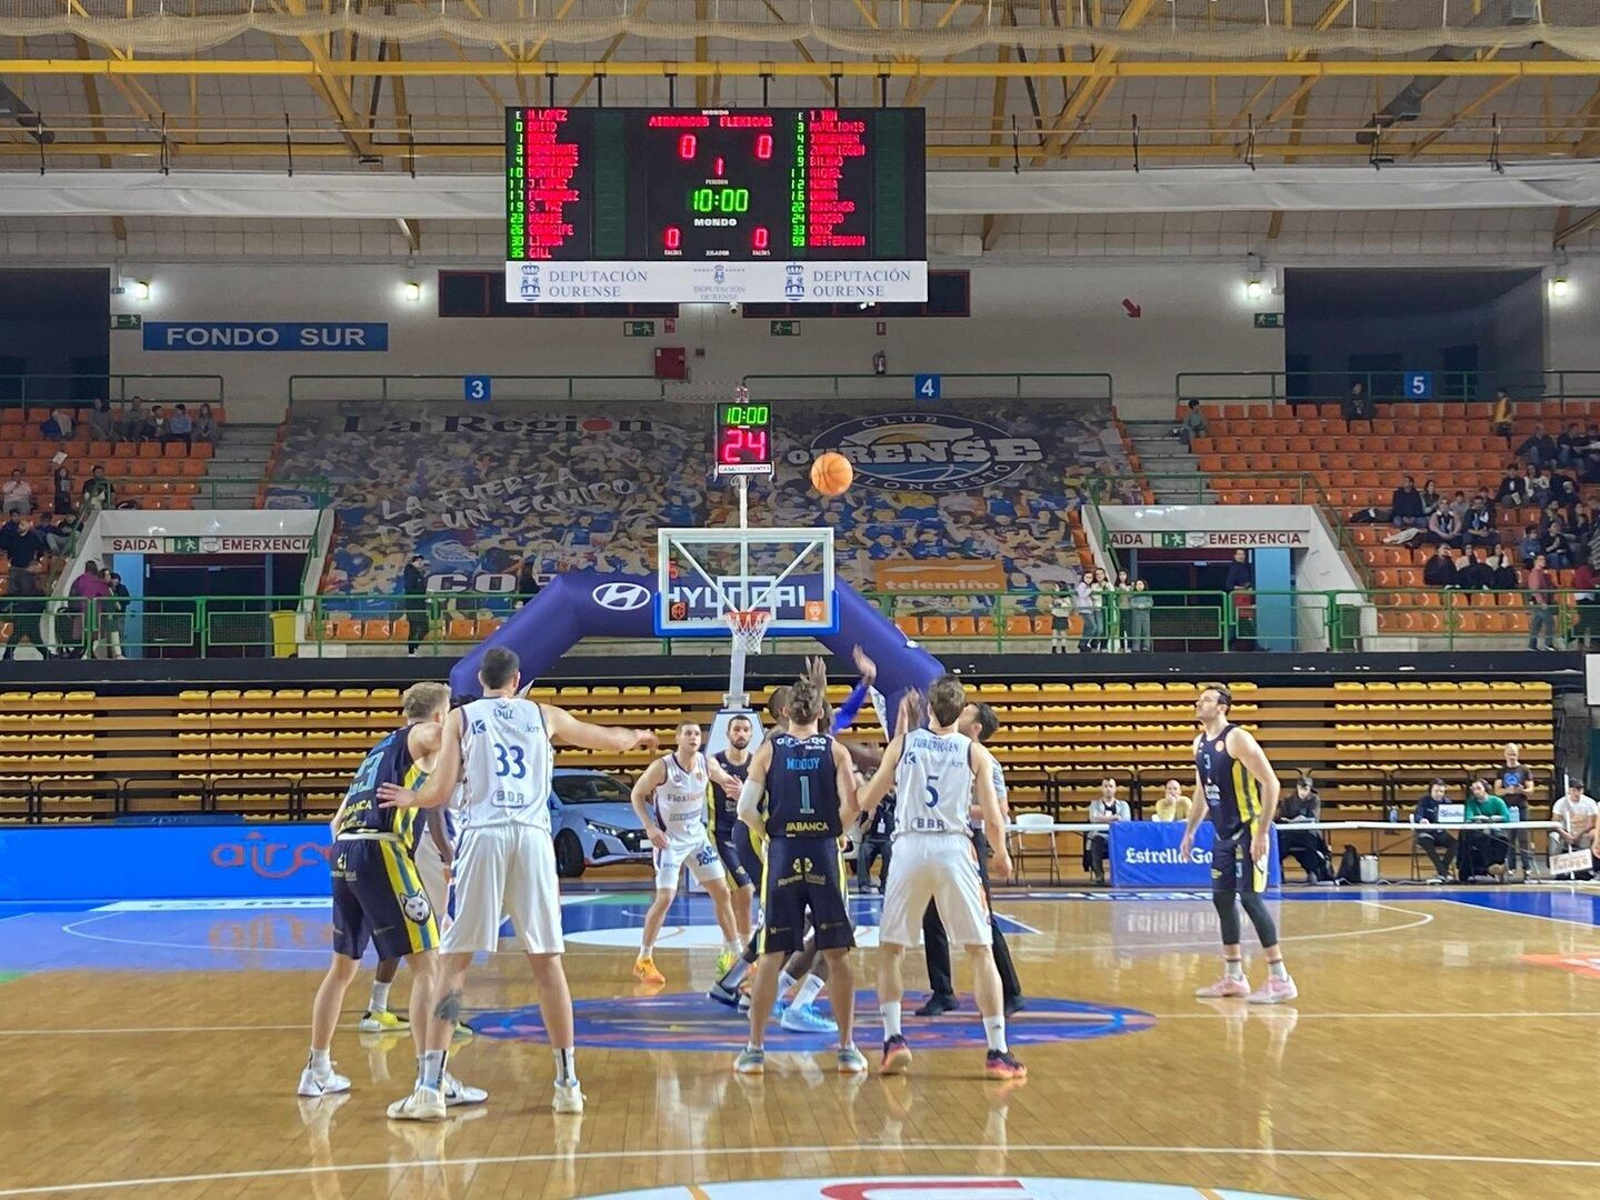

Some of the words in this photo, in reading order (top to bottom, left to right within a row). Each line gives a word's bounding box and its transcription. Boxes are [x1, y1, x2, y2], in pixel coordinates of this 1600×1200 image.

[798, 122, 804, 133] 3
[797, 134, 804, 144] 4
[682, 135, 696, 158] 0
[758, 135, 772, 158] 0
[797, 145, 804, 155] 5
[797, 157, 804, 167] 9
[510, 167, 523, 178] 10
[791, 168, 804, 178] 11
[510, 179, 523, 189] 11
[791, 179, 804, 189] 12
[510, 190, 523, 200] 17
[694, 189, 748, 212] 10:00
[791, 190, 804, 200] 16
[510, 202, 523, 212] 19
[694, 218, 737, 226] MONDO
[668, 229, 679, 248] 0
[755, 229, 767, 248] 0
[549, 268, 647, 282] DEPUTACIÓN
[813, 268, 911, 282] DEPUTACIÓN
[549, 286, 621, 297] OURENSE
[813, 286, 885, 297] OURENSE
[167, 327, 279, 346] FONDO
[300, 327, 366, 346] SUR
[472, 380, 484, 399] 3
[921, 379, 934, 396] 4
[1412, 376, 1424, 394] 5
[728, 407, 768, 424] 10:00
[862, 416, 938, 428] CLUB
[725, 430, 765, 462] 24
[853, 464, 1011, 490] LONCESTO
[382, 496, 426, 520] LA
[436, 467, 578, 507] FUERZA
[375, 519, 425, 544] DE
[441, 504, 493, 529] UN
[504, 478, 635, 514] EQUIPO
[113, 539, 158, 551] SAIDA
[1110, 533, 1143, 544] AIDA
[1209, 533, 1302, 544] EMERXENCIA
[885, 580, 1000, 590] telemiño
[668, 586, 806, 608] HYUNDAI
[494, 743, 526, 779] 33
[786, 757, 820, 770] MOODY
[1204, 754, 1211, 769] 3
[800, 776, 815, 814] 1
[926, 775, 939, 808] 5
[787, 821, 829, 832] ABANCA
